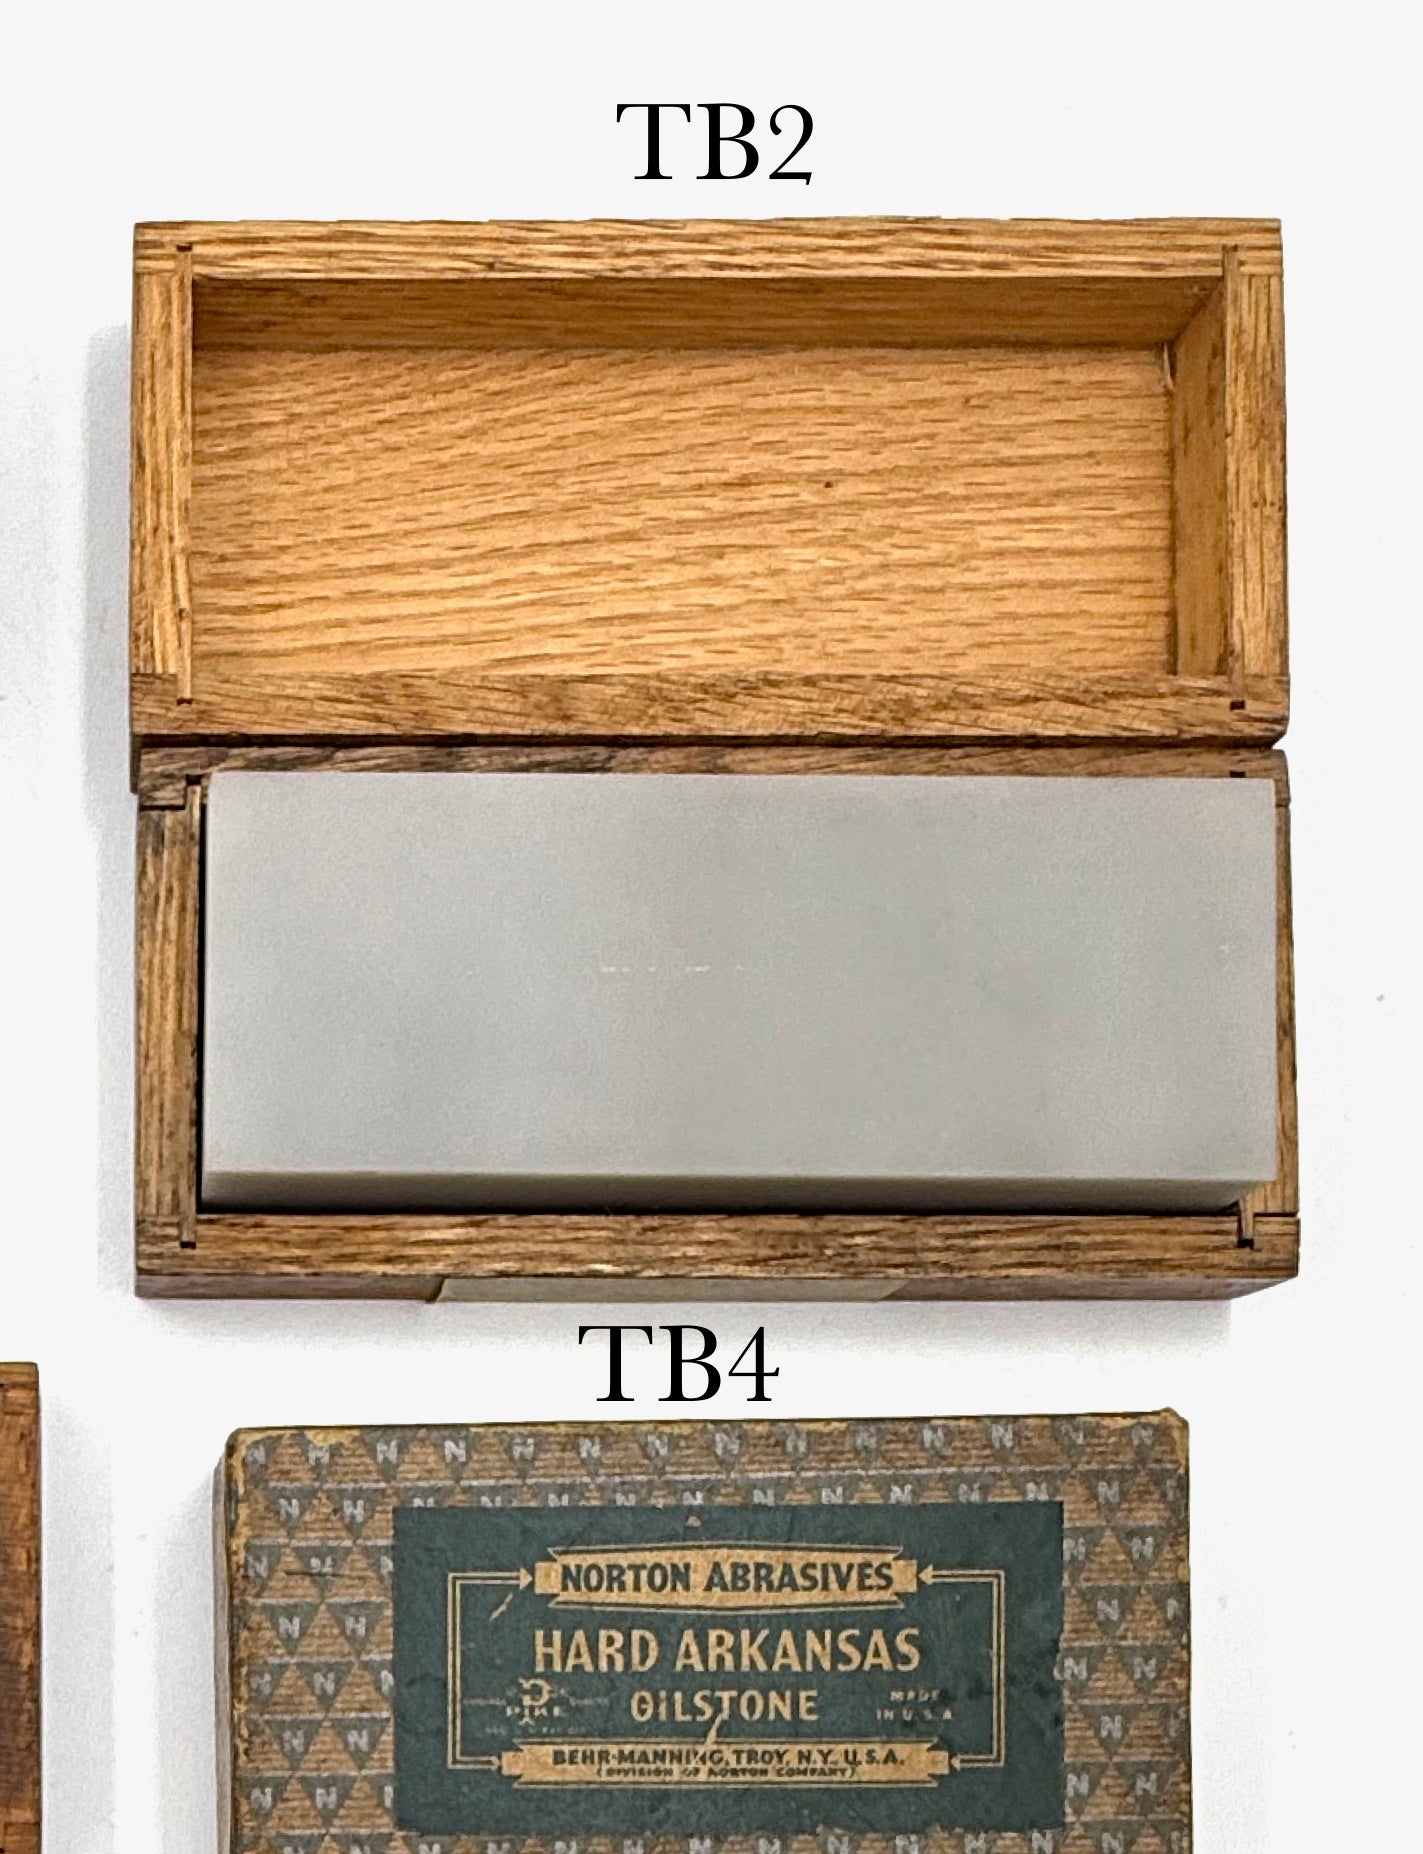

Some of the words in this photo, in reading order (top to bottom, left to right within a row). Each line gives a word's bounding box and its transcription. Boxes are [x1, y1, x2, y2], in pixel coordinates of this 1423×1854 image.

[561, 1562, 691, 1593] NORTON
[704, 1561, 893, 1592] ABRASIVES
[534, 1629, 660, 1673] HARD
[676, 1627, 920, 1673] ARKANSAS
[630, 1689, 819, 1722] OILSTONE
